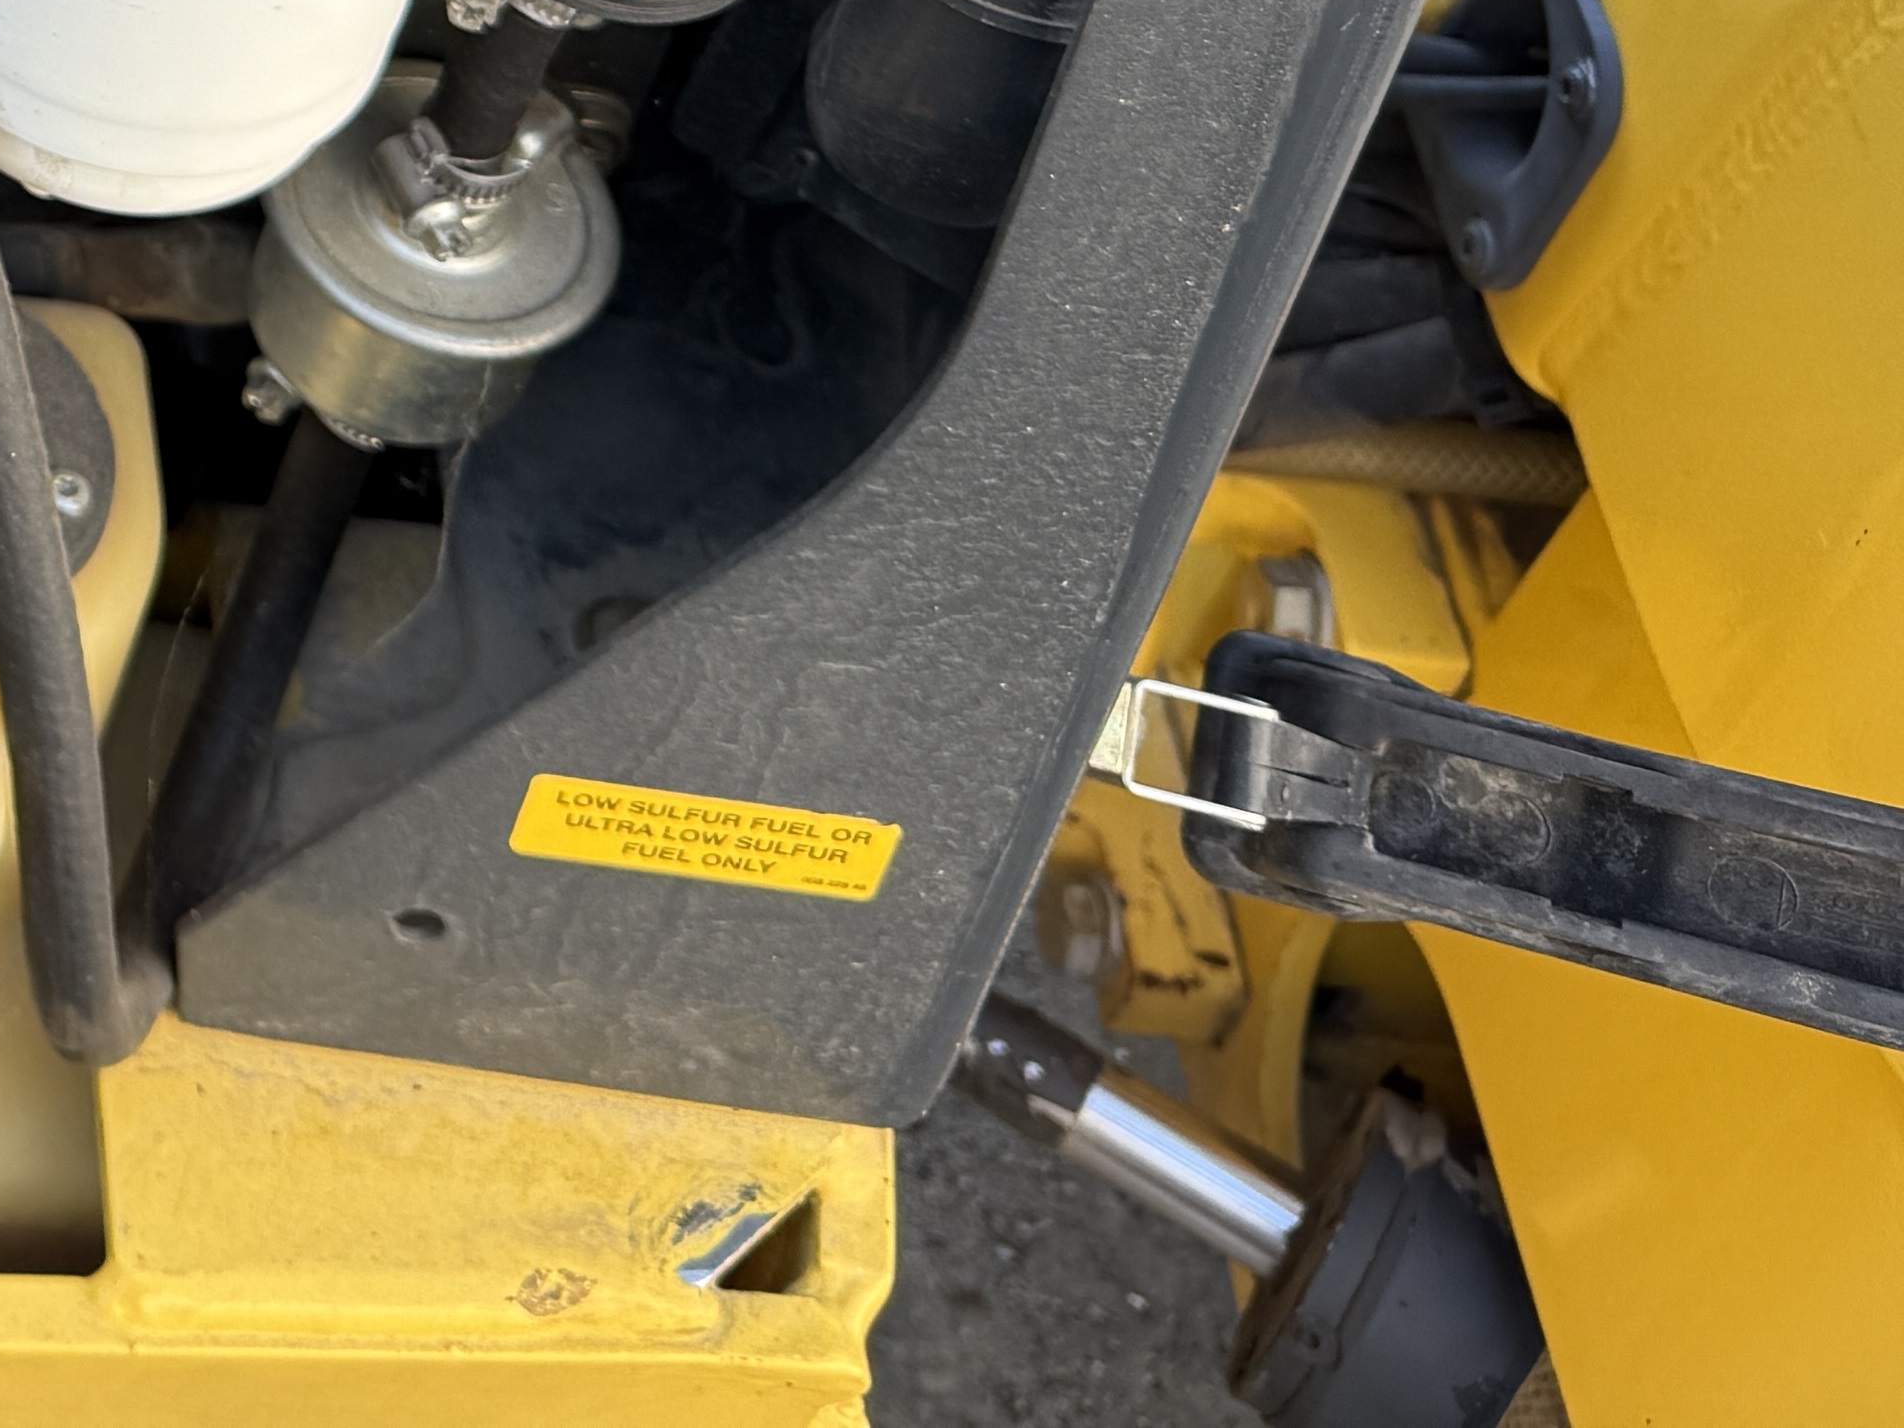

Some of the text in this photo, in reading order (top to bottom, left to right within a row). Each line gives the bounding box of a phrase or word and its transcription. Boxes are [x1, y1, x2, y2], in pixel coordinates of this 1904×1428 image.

[555, 789, 873, 846] LOW SULFUR FUEL OR
[564, 811, 849, 865] ULTRA LOW SULFUR
[620, 841, 778, 875] FUEL ONLY
